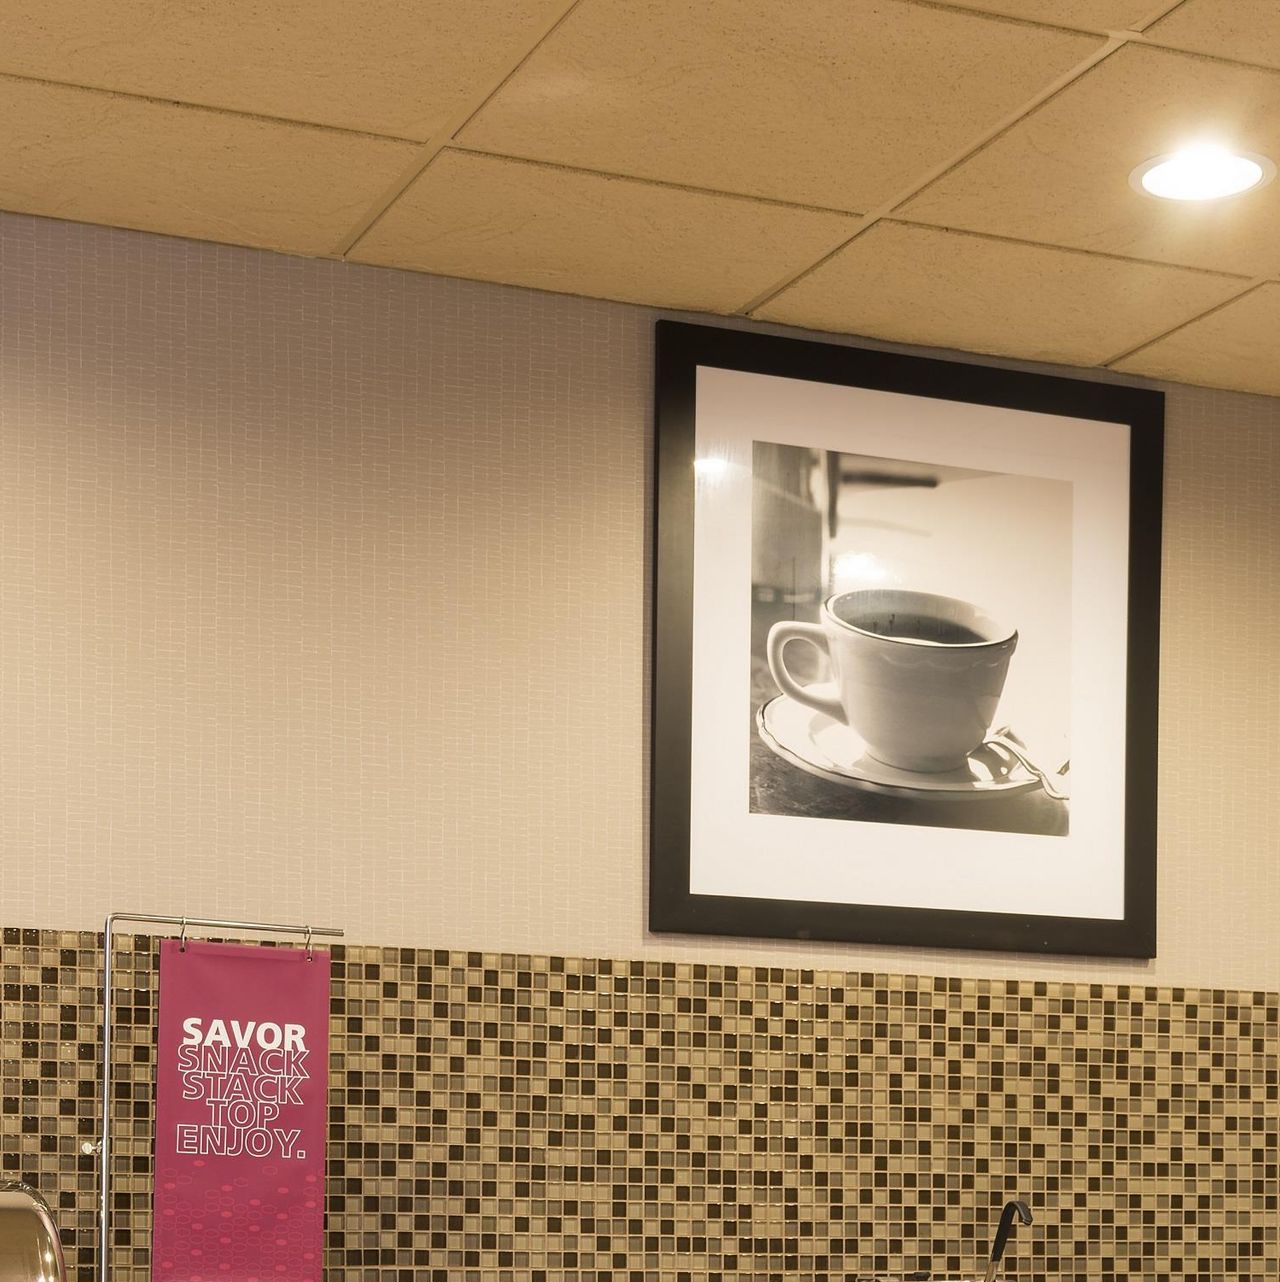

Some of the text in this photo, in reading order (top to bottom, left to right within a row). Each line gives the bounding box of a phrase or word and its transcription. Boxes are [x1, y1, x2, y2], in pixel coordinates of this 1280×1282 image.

[182, 1017, 306, 1051] SAVOR
[177, 1044, 310, 1079] SNACK
[182, 1071, 304, 1105] STACK
[206, 1099, 280, 1129] TOP
[176, 1124, 306, 1159] ENJOY.
